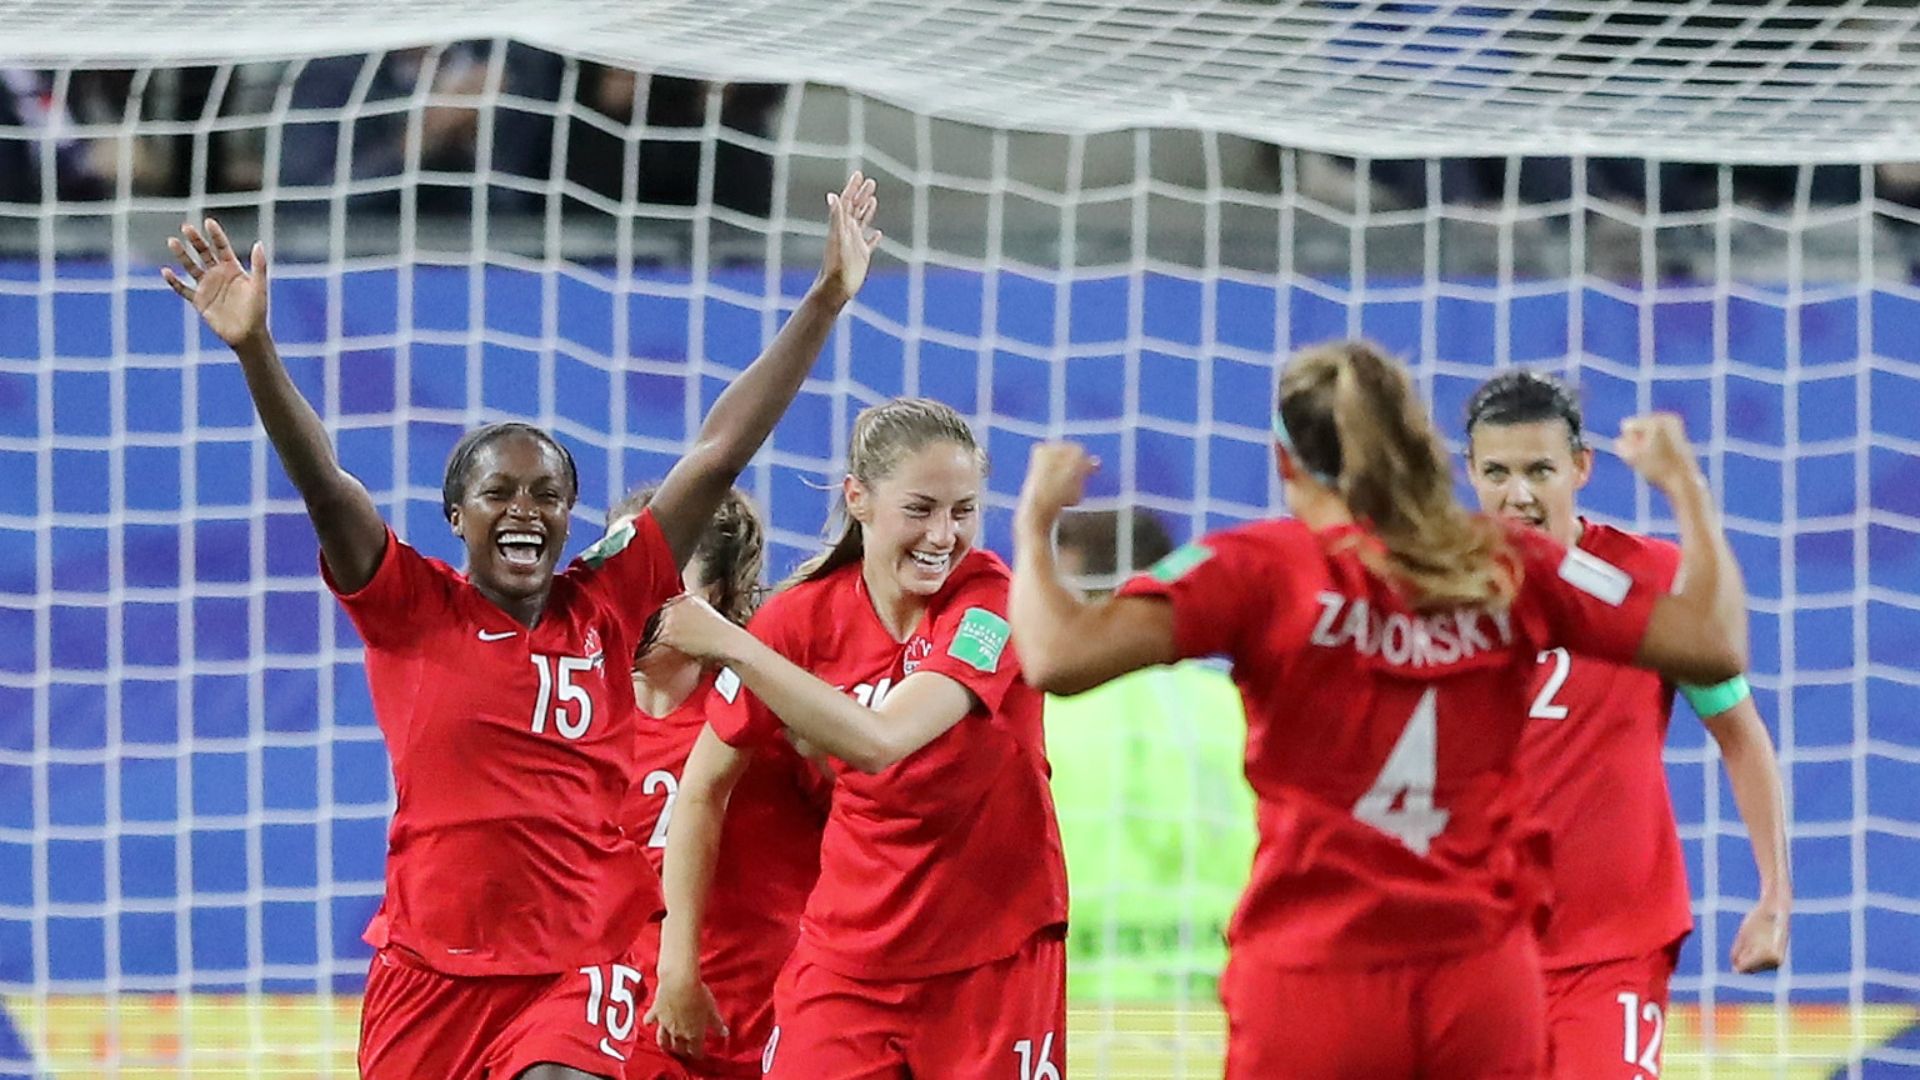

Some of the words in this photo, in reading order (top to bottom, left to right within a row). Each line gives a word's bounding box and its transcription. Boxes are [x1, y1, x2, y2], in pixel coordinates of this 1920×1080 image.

[530, 653, 593, 740] 15
[1529, 646, 1571, 720] 2
[1352, 685, 1451, 859] 4
[579, 963, 643, 1041] 15
[1617, 991, 1664, 1077] 12
[1013, 1031, 1061, 1080] 16
